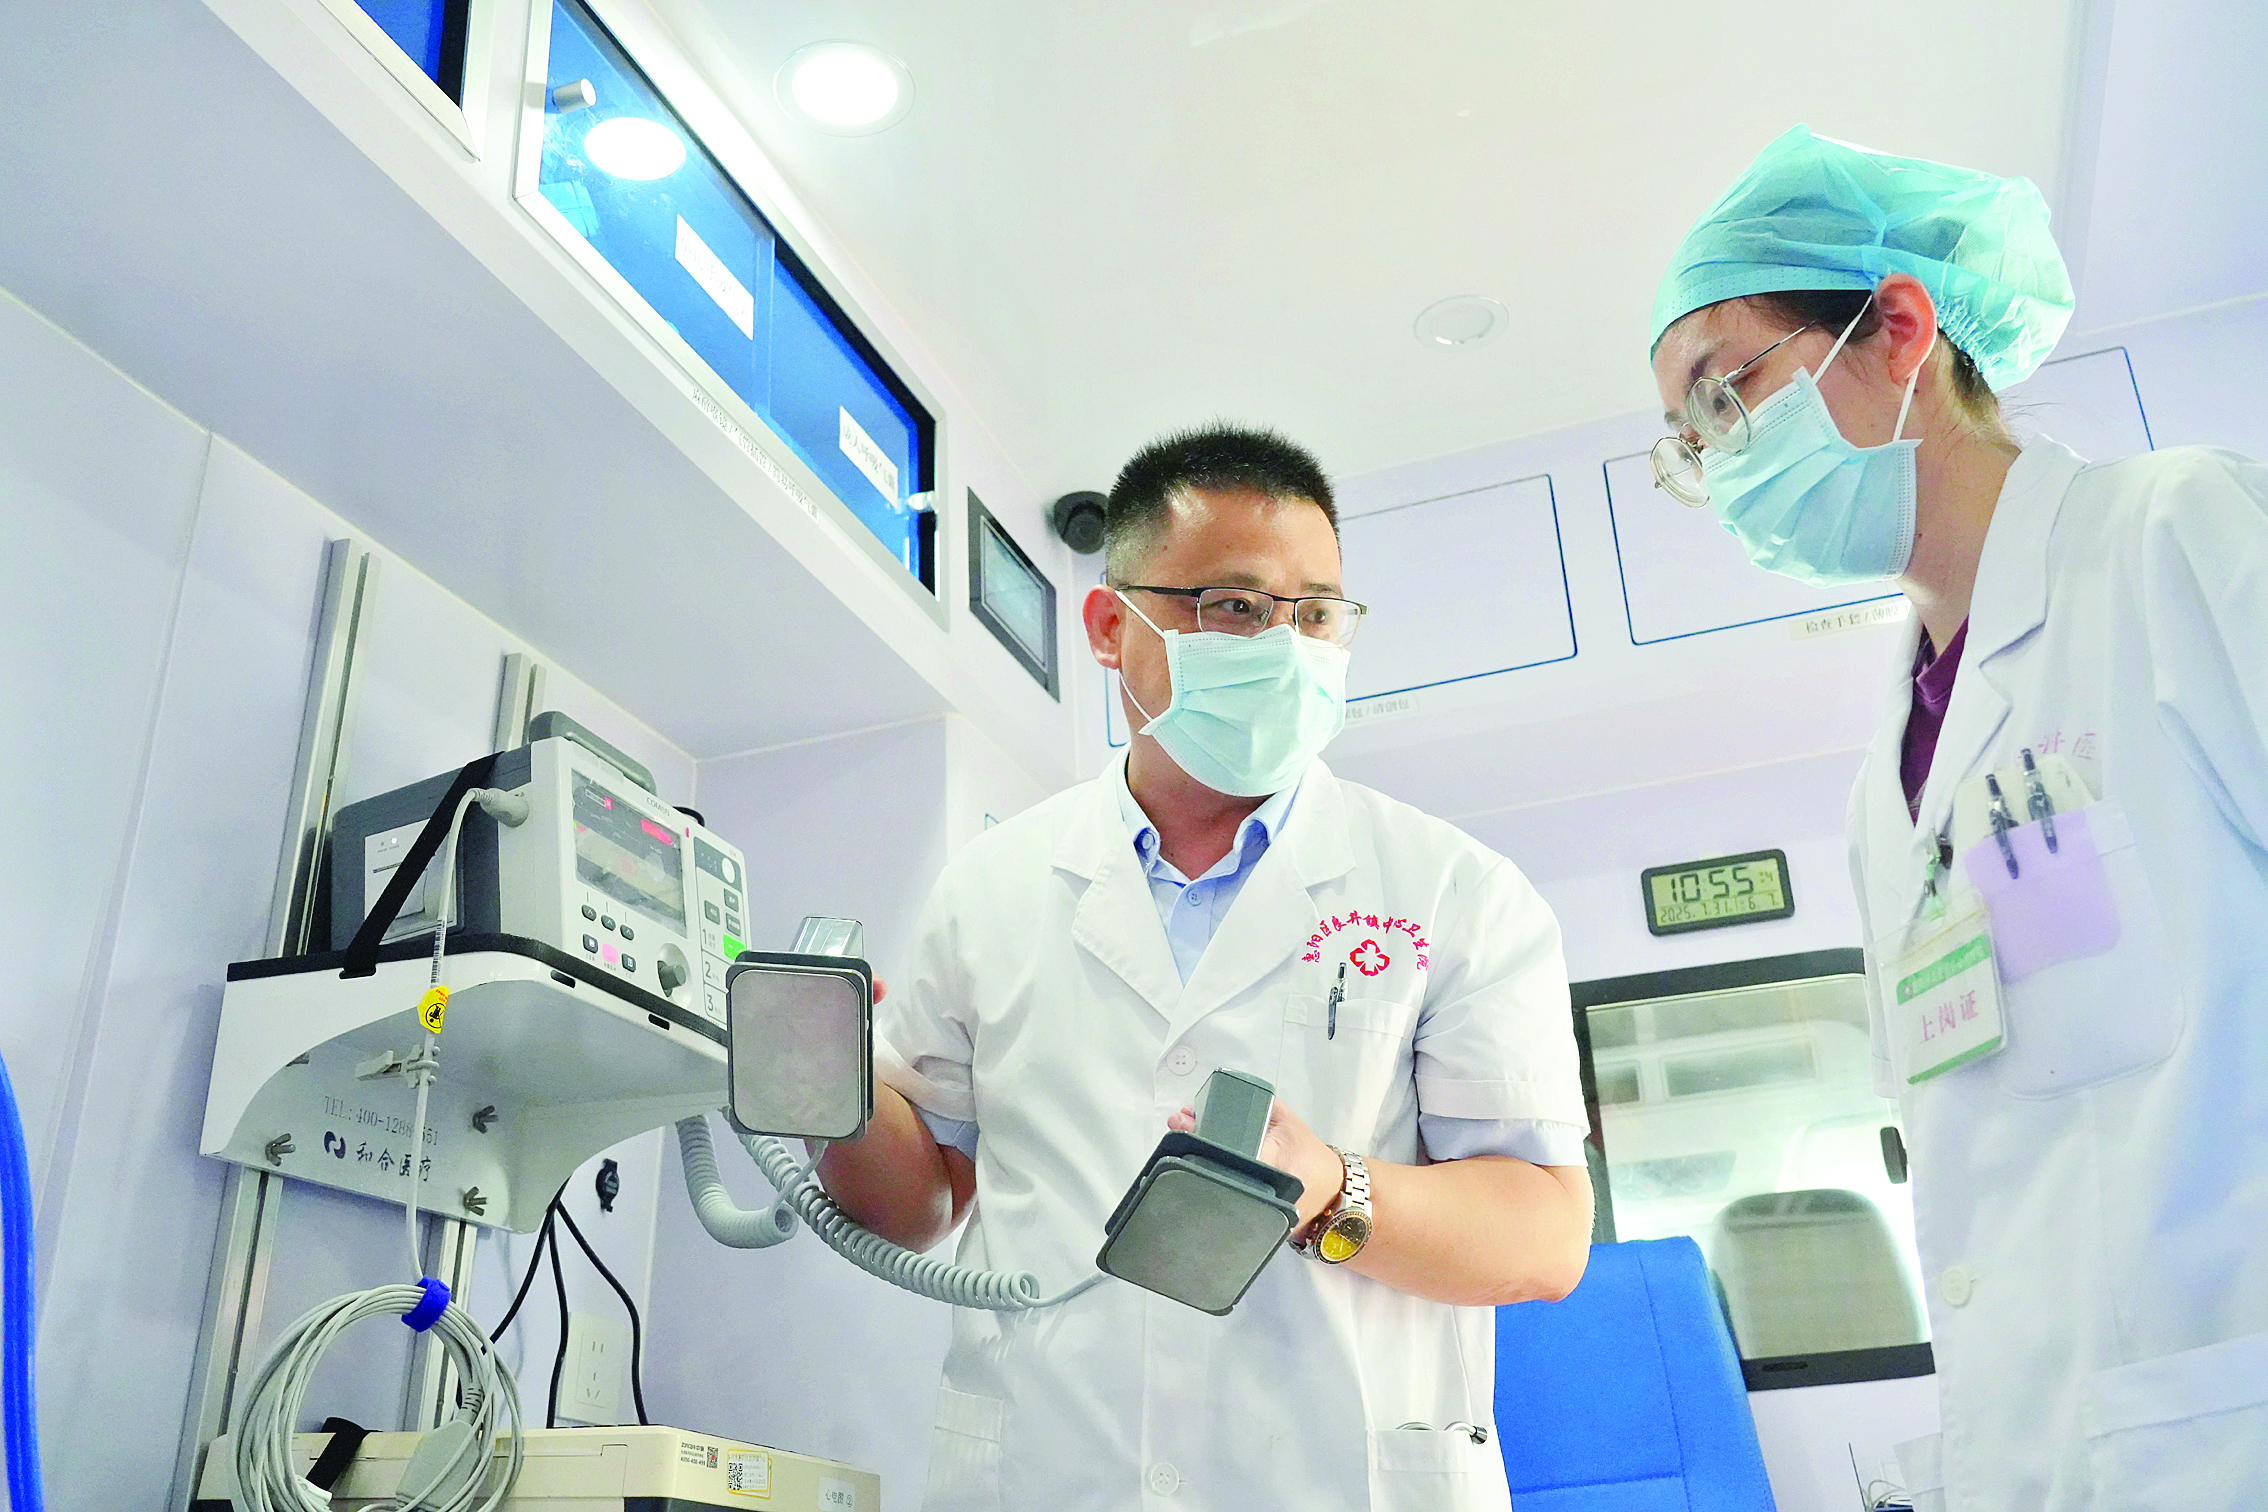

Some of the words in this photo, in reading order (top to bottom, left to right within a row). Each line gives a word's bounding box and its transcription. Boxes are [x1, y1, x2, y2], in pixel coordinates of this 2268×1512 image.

[704, 961, 712, 979] 2
[707, 994, 714, 1012] 3
[1920, 989, 1979, 1042] 上岗证
[825, 1488, 844, 1505] 心电图
